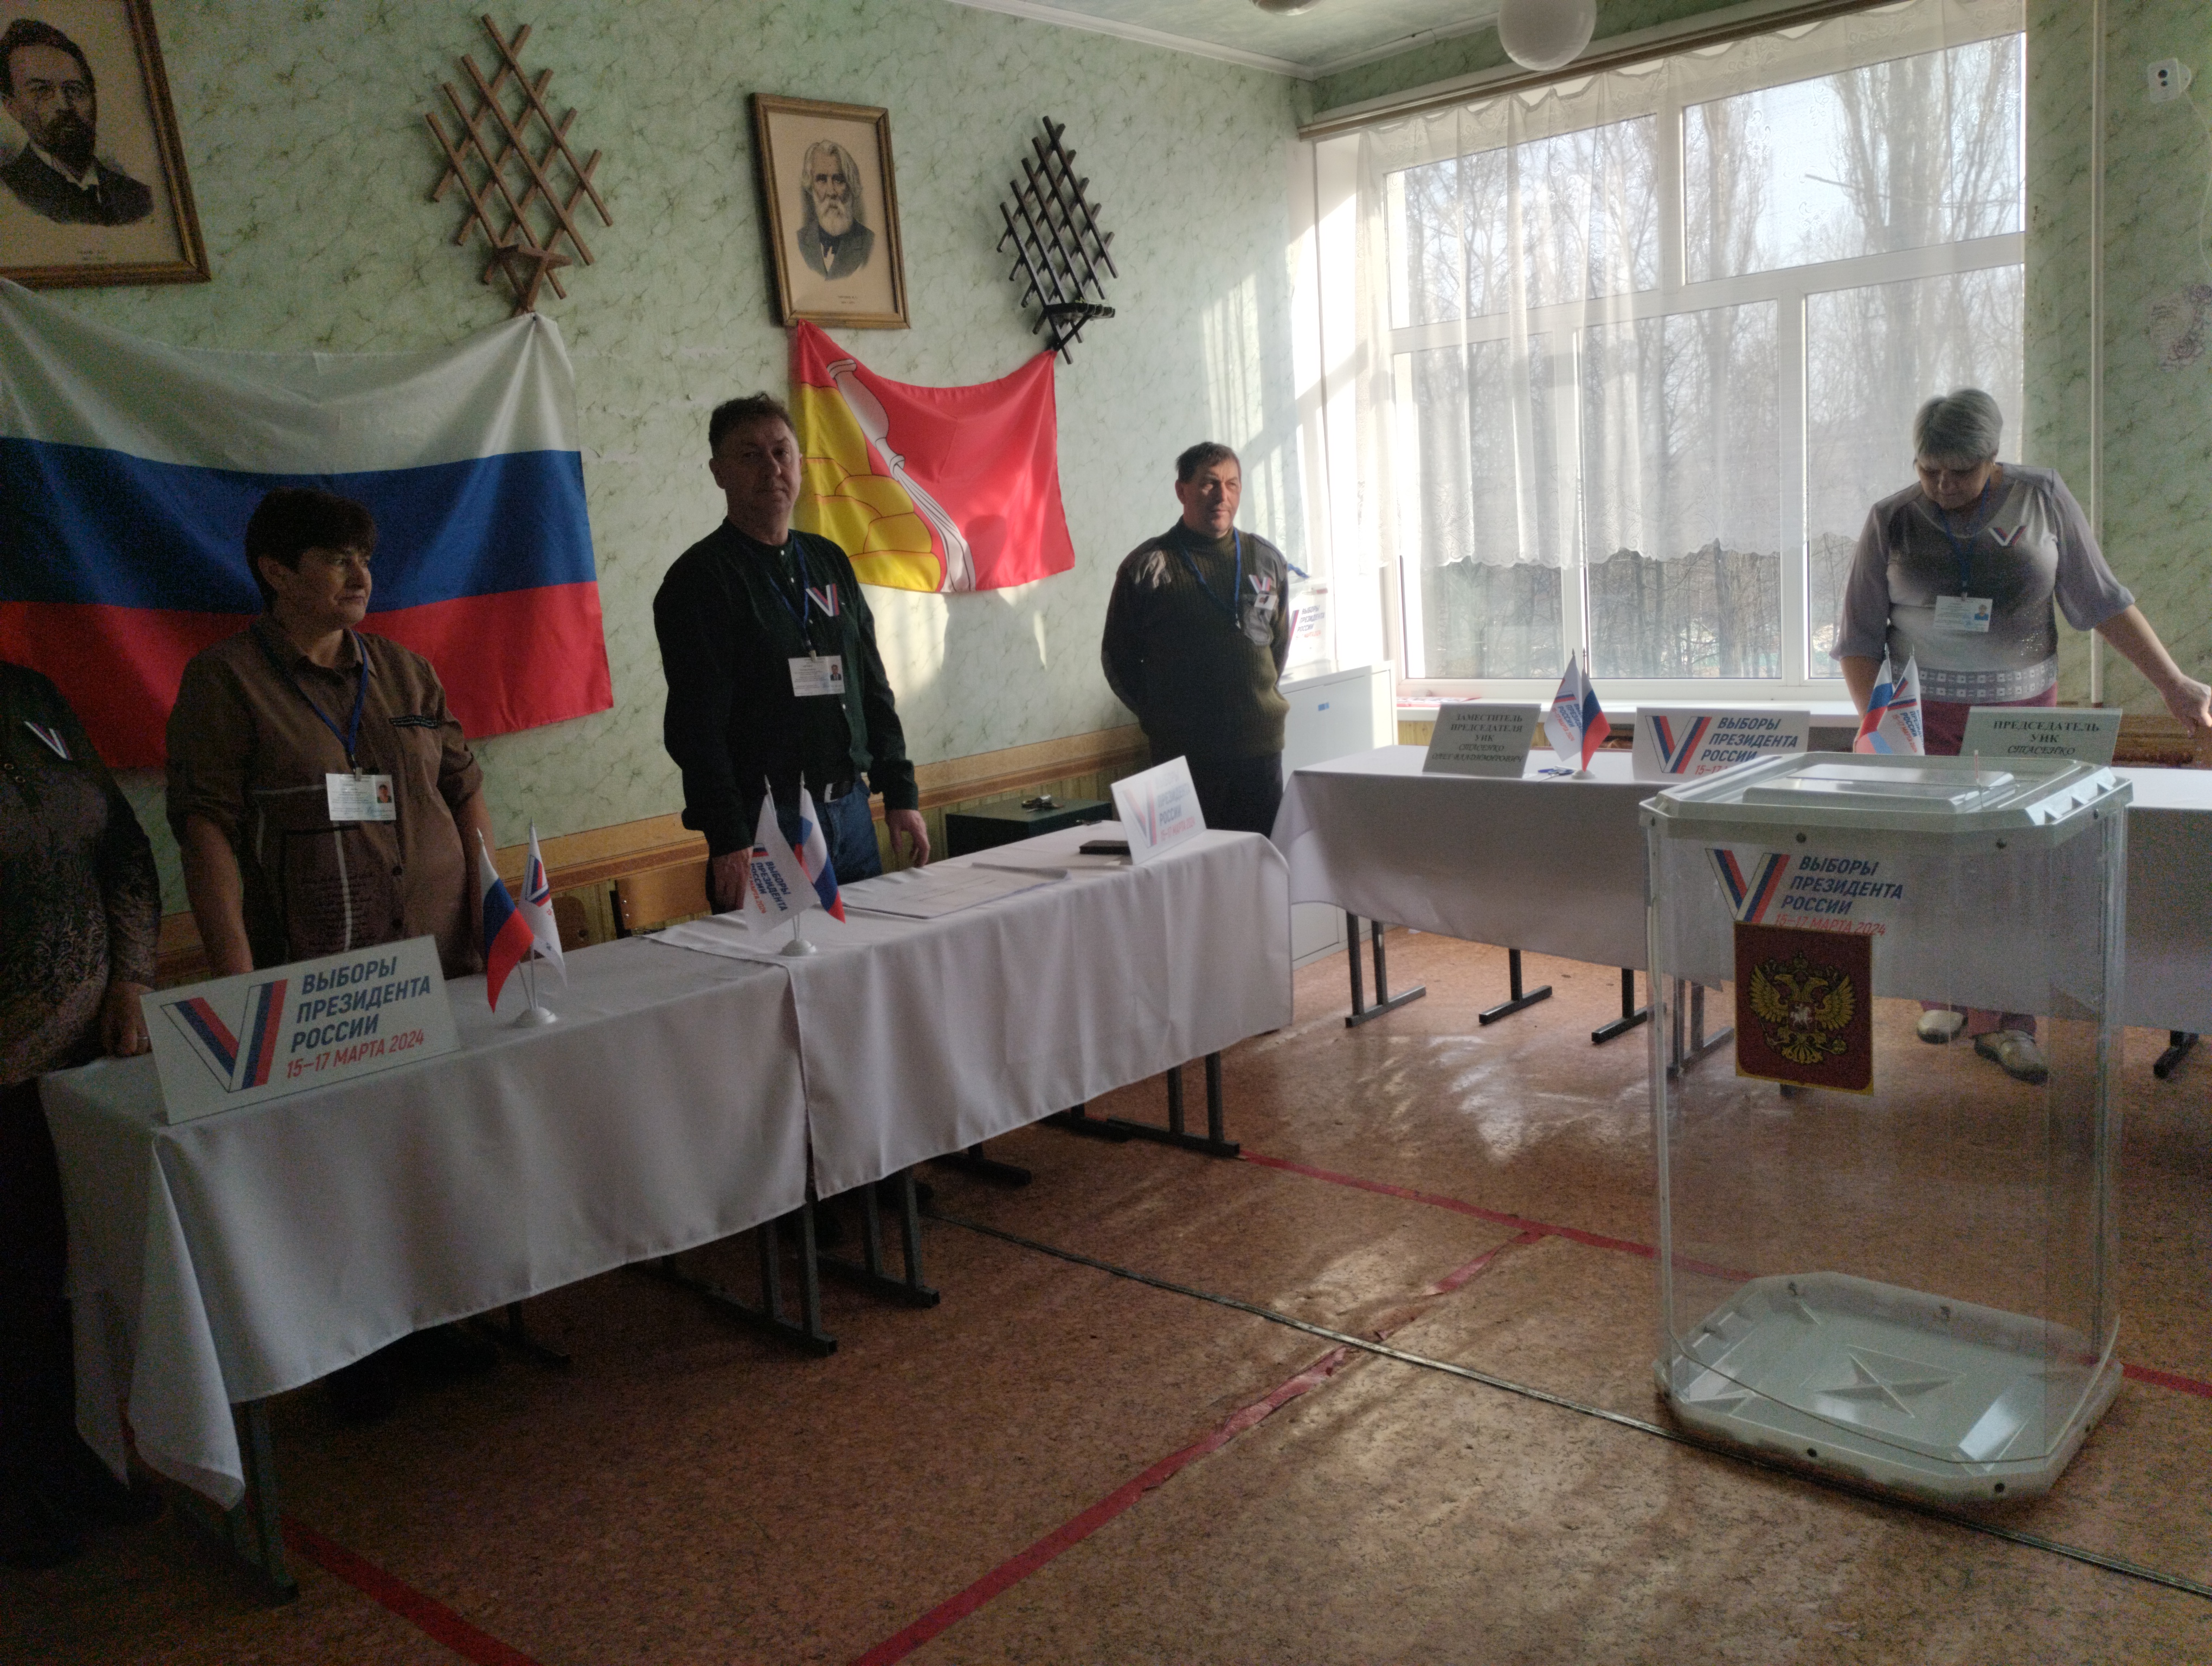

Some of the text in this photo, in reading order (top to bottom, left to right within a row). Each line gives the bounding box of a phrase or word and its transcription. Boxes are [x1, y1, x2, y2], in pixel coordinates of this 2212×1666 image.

[1456, 714, 1523, 722] ЗАМЕСТИТЕЛЬ
[1558, 706, 1576, 728] РОССИИ
[1718, 717, 1781, 731] ВЫБОРЫ
[1900, 712, 1918, 737] РОССИИ
[1993, 720, 2099, 731] ПРЕДСЕДАТЕЛЬ
[1450, 724, 1523, 732] ПРЕДСЕДАТЕЛЯ
[1709, 733, 1798, 748] ПРЕЗИДЕНТА
[2030, 734, 2060, 743] УИК
[1701, 749, 1758, 762] РОССИИ
[1159, 805, 1182, 826] РОССИИ
[1799, 856, 1879, 876] ВЫБОРЫ
[756, 862, 788, 911] ПРЕЗИДЕНТА
[765, 861, 792, 895] ВЫБОРЫ
[1789, 876, 1904, 899] ПРЕЗИДЕНТА
[1780, 895, 1853, 915] РОССИИ
[1810, 917, 1853, 933] МАРТА
[1854, 921, 1887, 936] 2024
[301, 956, 397, 995] ВЫБОРЫ
[297, 976, 430, 1024] ПРЕЗИДЕНТА
[291, 1014, 380, 1053] РОССИИ
[333, 1039, 385, 1067] МАРТА
[389, 1029, 425, 1054] 2024
